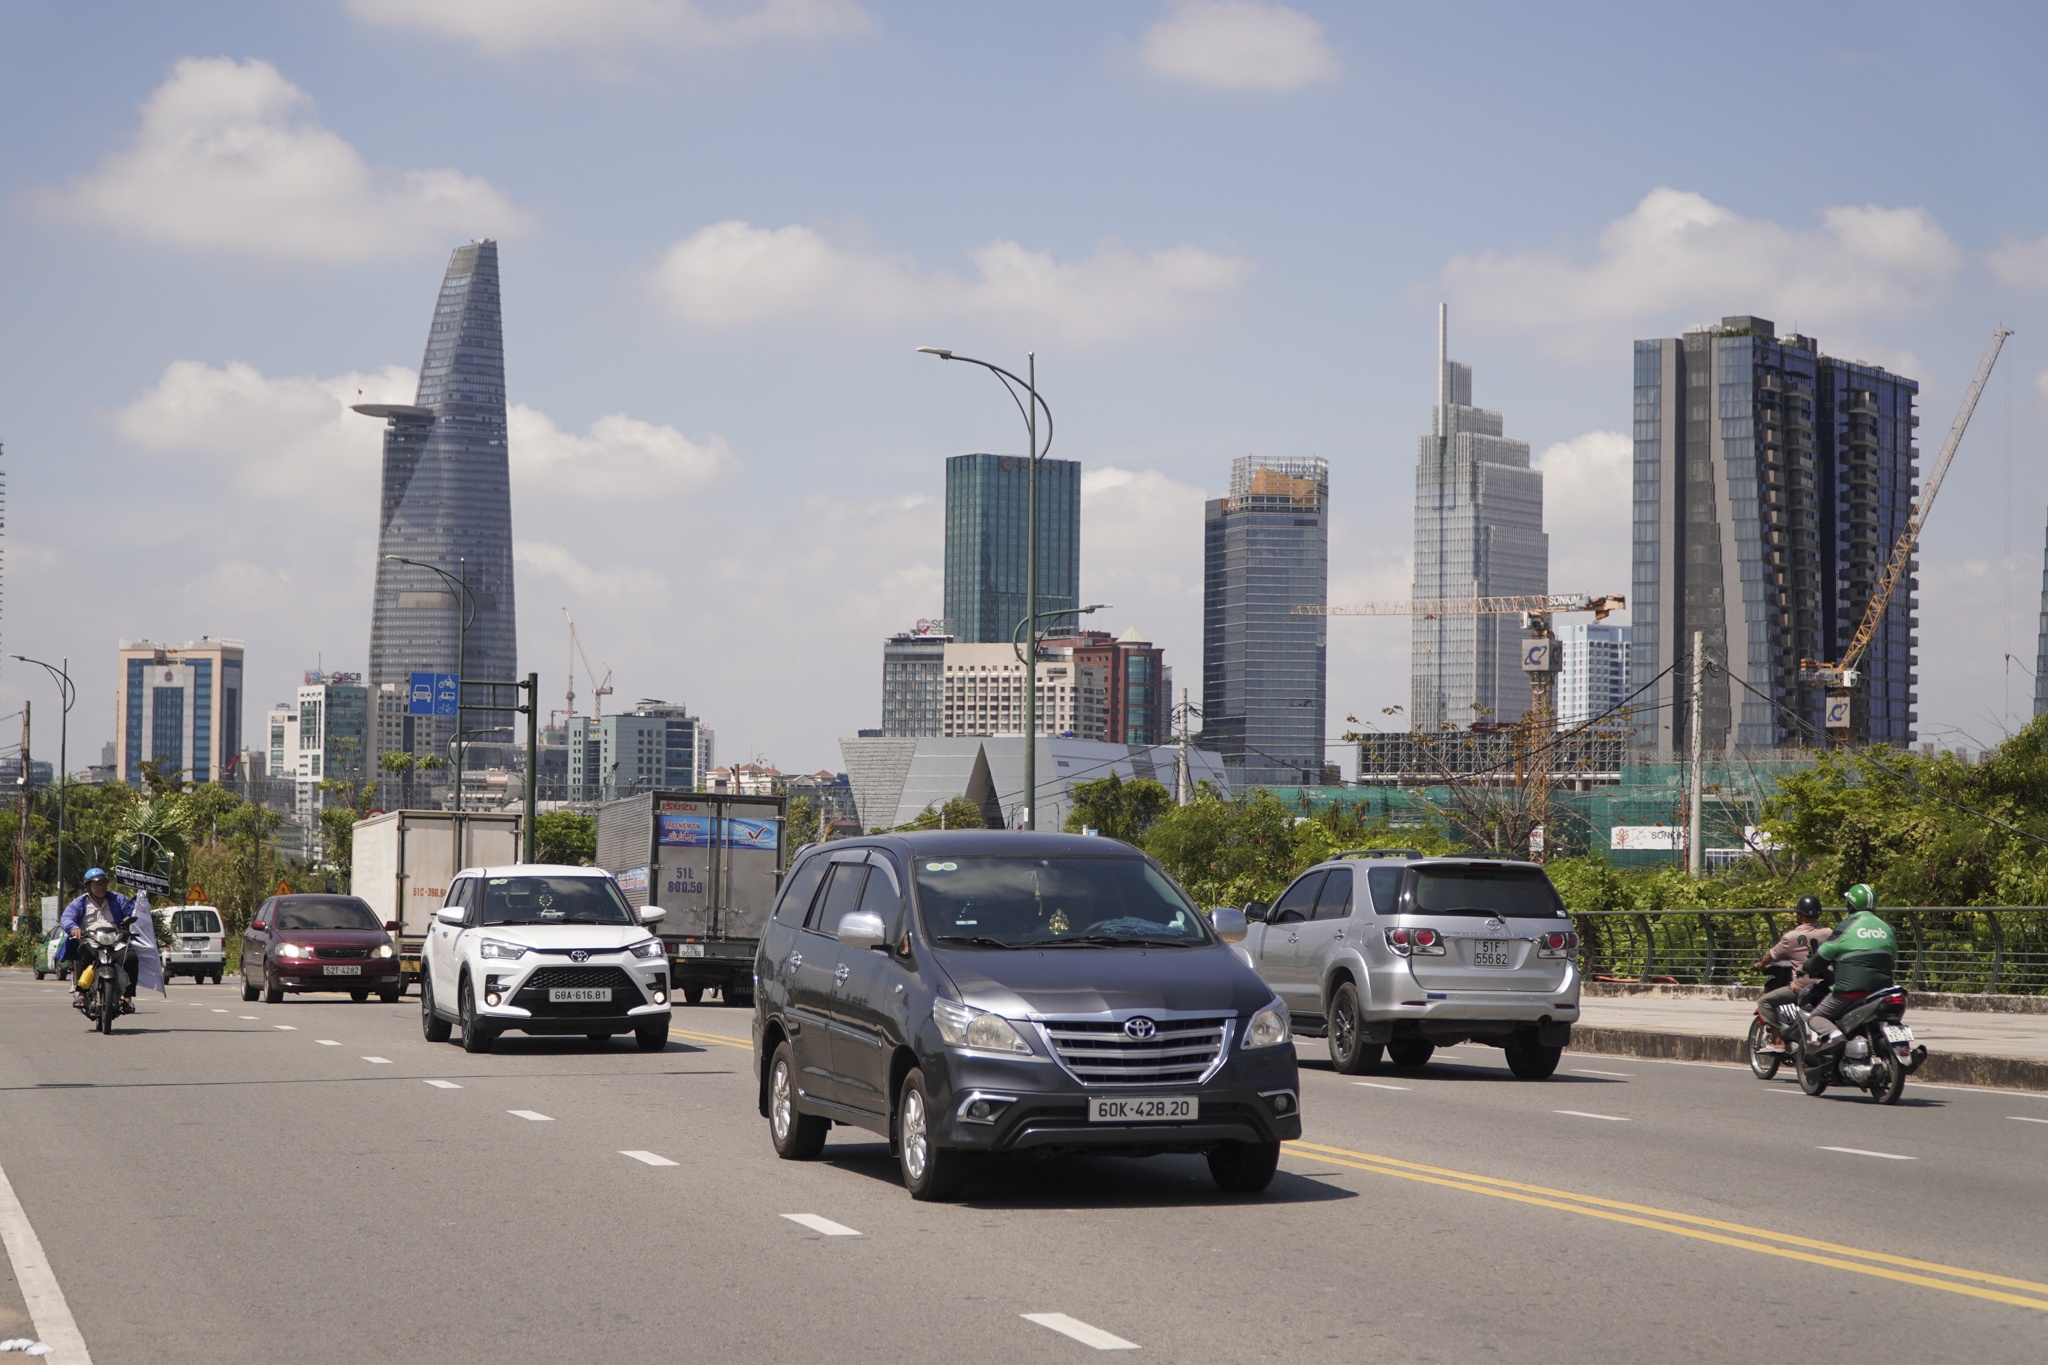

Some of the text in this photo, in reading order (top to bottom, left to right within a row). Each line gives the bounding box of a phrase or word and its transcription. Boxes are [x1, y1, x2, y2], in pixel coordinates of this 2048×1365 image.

[1280, 462, 1317, 474] Hilton
[1548, 595, 1580, 606] SONKIM
[343, 673, 361, 681] SCB
[662, 802, 698, 811] ISUZU
[676, 867, 694, 879] 51L
[668, 881, 703, 894] 800.50
[1856, 927, 1888, 939] Grab
[1483, 941, 1500, 953] 51F
[1476, 953, 1508, 965] 556.82
[325, 966, 359, 975] 52T-4282
[554, 990, 606, 1000] 68A-616.81
[1098, 1101, 1190, 1117] 60K-428.20
